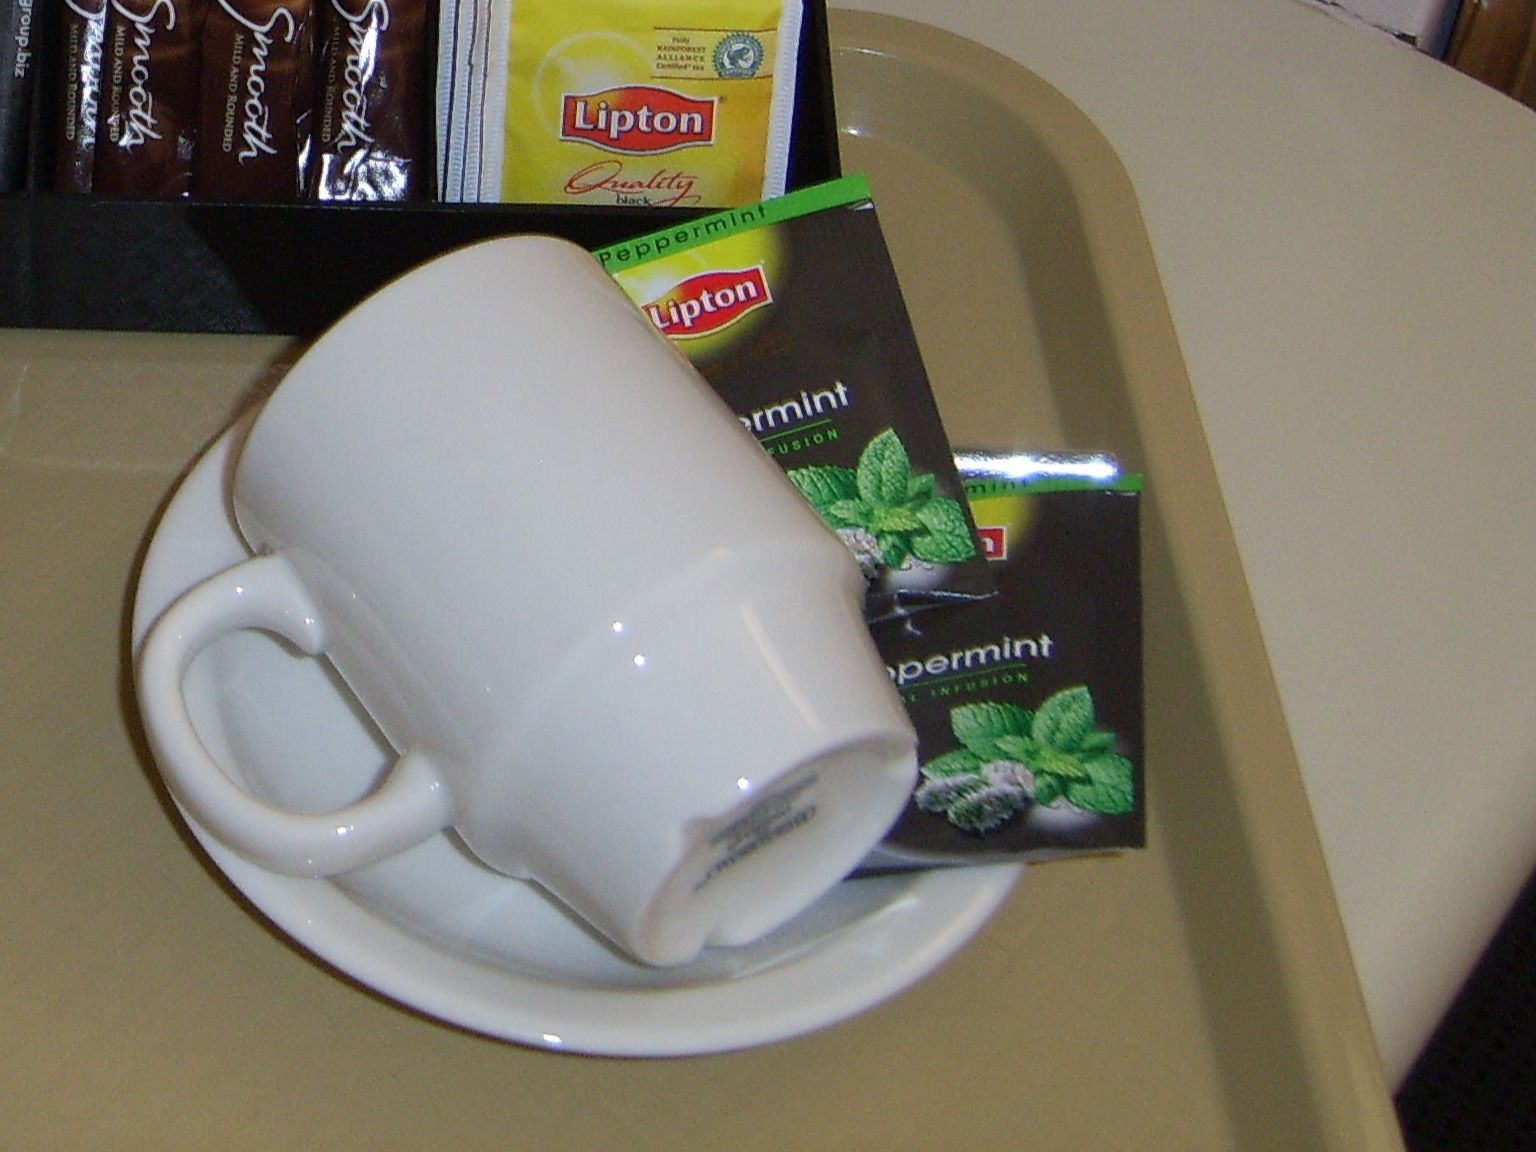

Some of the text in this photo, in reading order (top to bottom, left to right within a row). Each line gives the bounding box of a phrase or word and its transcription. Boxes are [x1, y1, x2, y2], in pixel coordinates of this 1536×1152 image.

[113, 25, 126, 57] MILD
[111, 57, 124, 85] AND
[222, 33, 245, 153] MILD AND ROUNDED
[66, 84, 77, 141] ROUNDED
[322, 86, 336, 144] ROUNDED
[574, 99, 704, 140] Lipton
[563, 159, 702, 207] Quality
[616, 194, 655, 208] black
[598, 203, 767, 266] Peppermint
[649, 279, 759, 330] Lipton
[886, 633, 1055, 685] permint
[930, 672, 1029, 698] INFUSION
